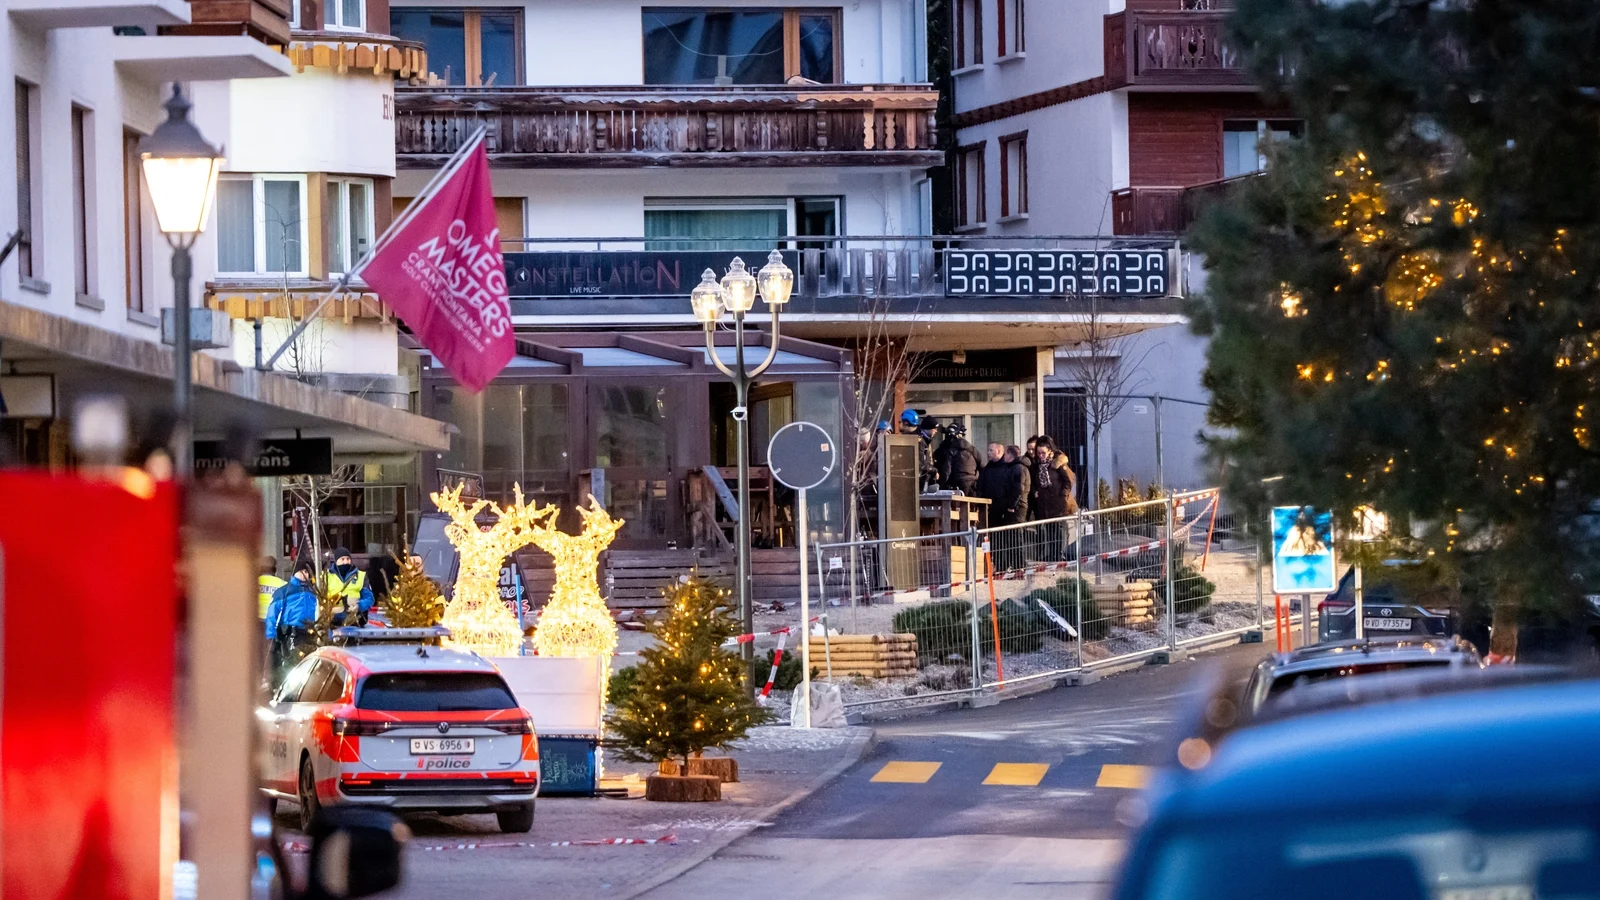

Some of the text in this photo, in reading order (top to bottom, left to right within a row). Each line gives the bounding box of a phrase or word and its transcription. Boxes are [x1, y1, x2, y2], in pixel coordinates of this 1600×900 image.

[400, 260, 422, 281] GOLF
[418, 235, 509, 338] MASTERS
[570, 286, 602, 294] LIVE MUSIC
[440, 289, 483, 337] MONTANA
[1371, 619, 1405, 628] VD 97357
[423, 740, 463, 751] VS 6956
[426, 757, 471, 771] police
